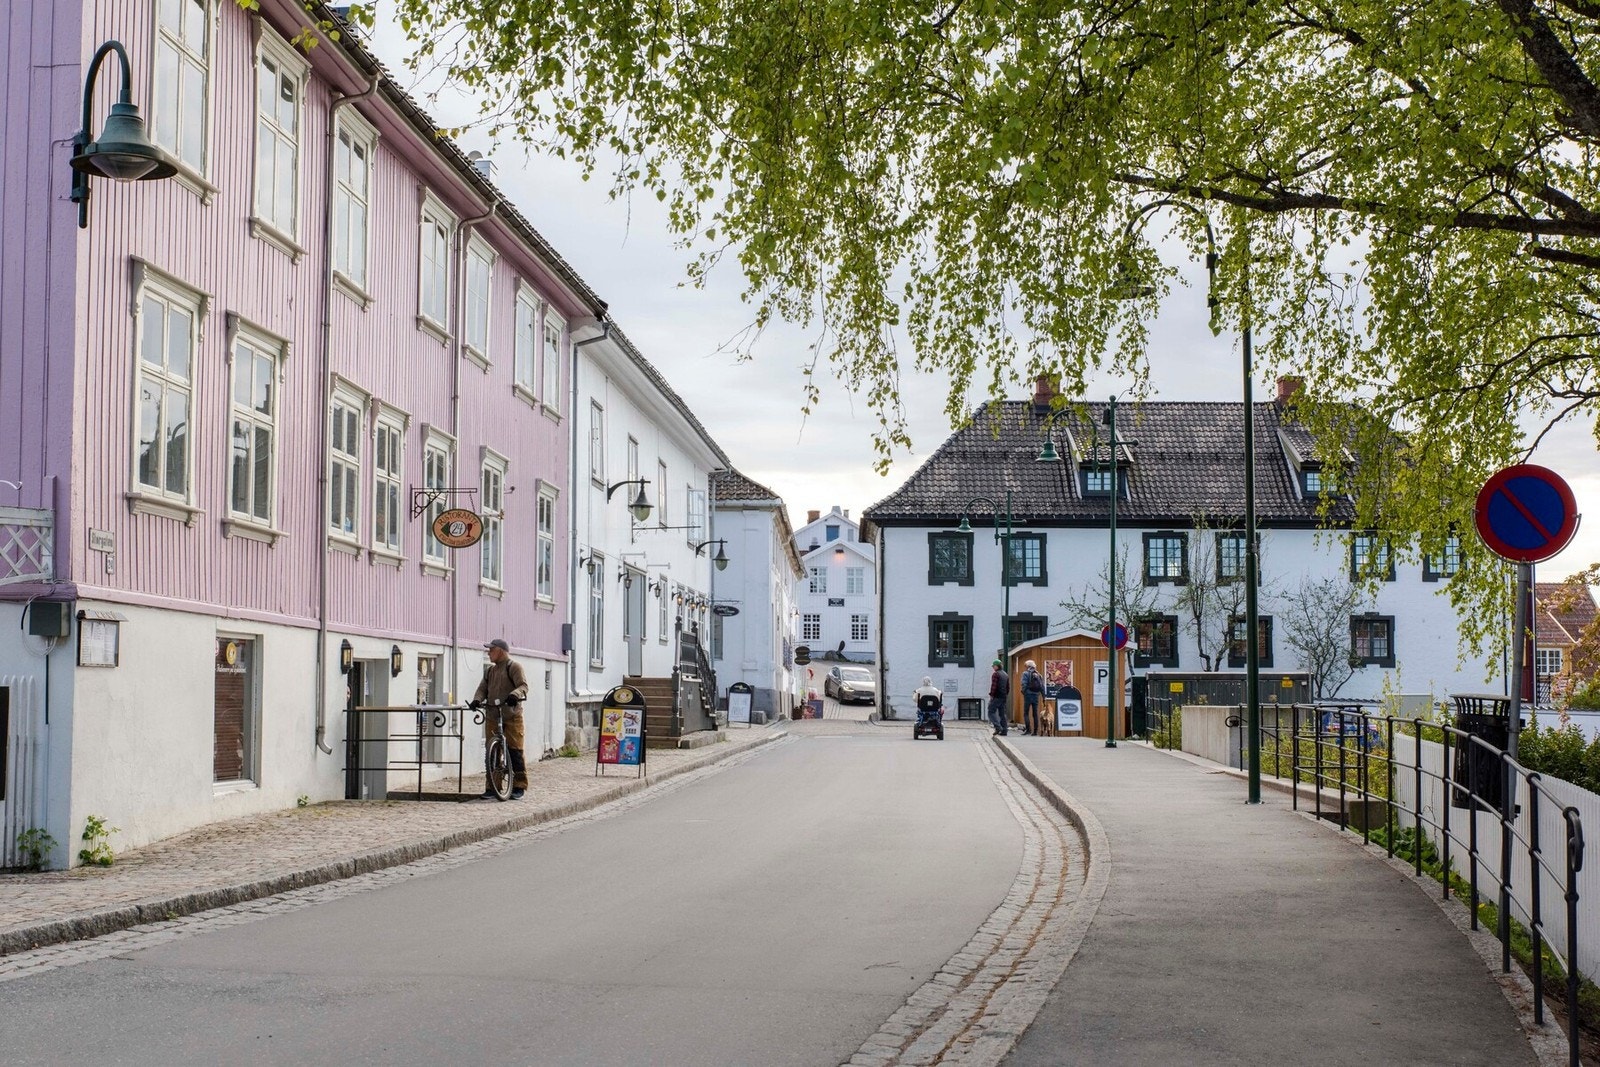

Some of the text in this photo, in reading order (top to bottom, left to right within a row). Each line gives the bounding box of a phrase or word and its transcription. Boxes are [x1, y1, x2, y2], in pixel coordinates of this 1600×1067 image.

[437, 511, 479, 526] RISTORANTE
[451, 523, 464, 535] 24
[1097, 668, 1108, 684] P
